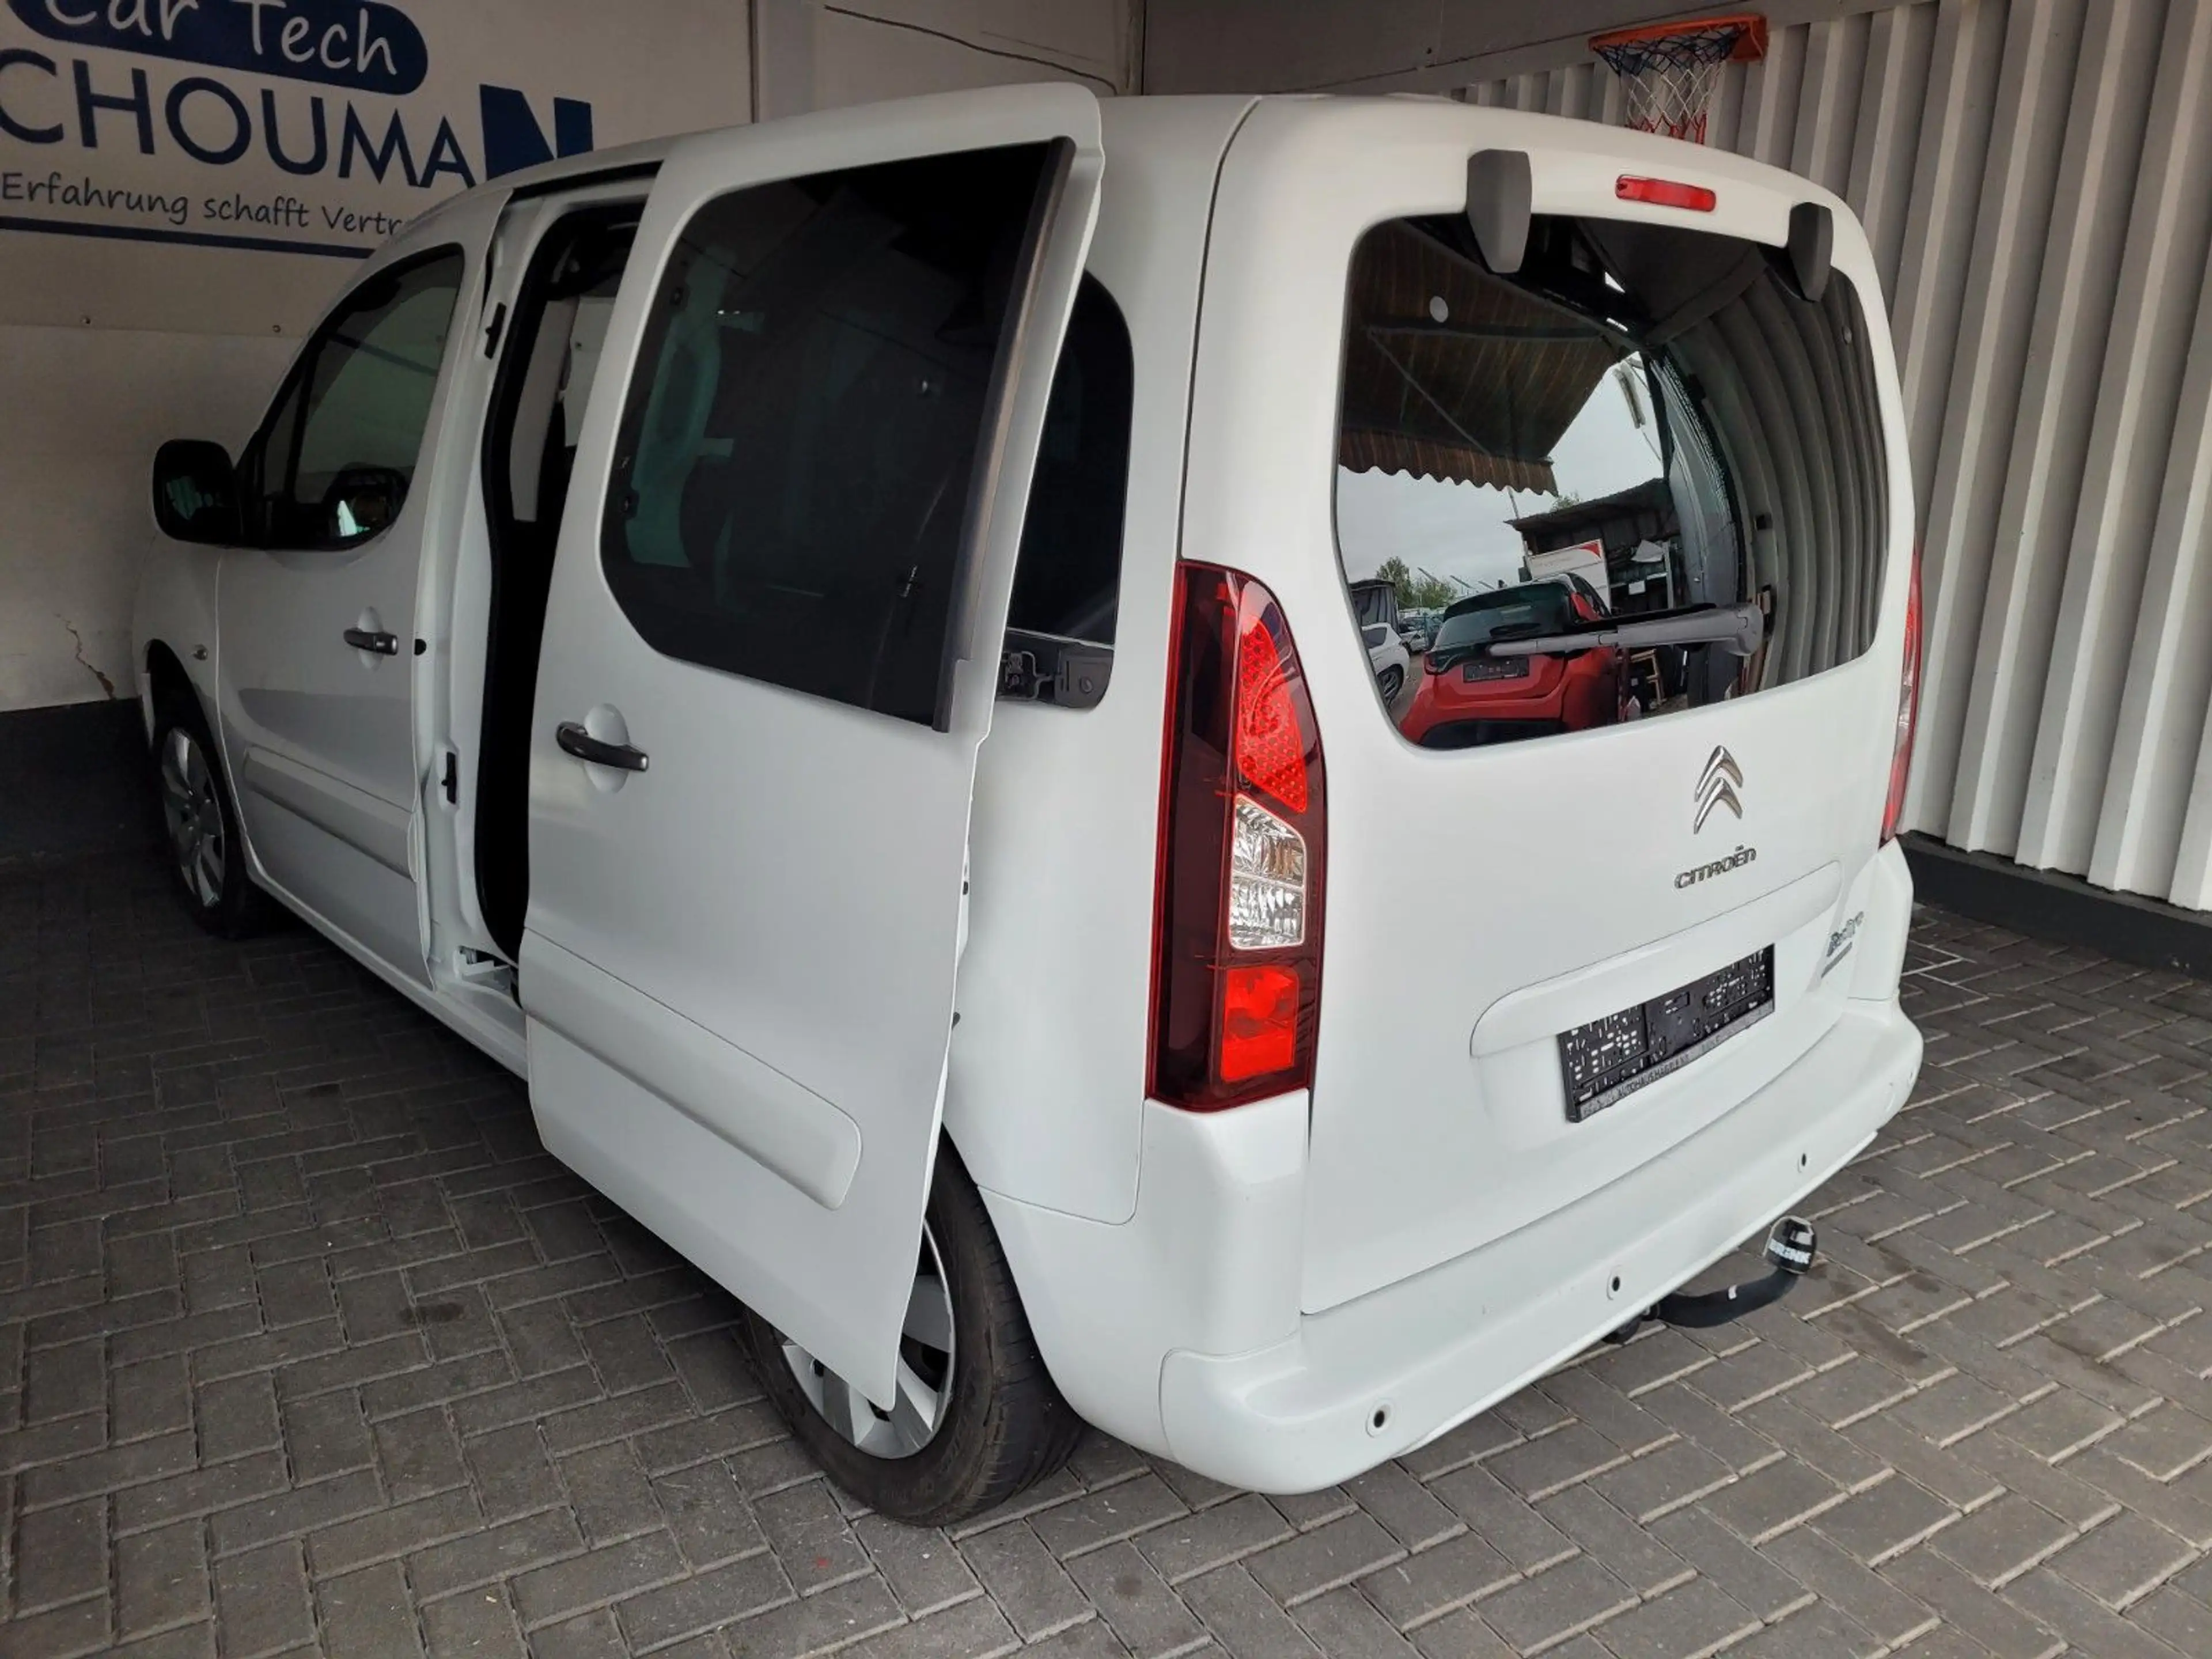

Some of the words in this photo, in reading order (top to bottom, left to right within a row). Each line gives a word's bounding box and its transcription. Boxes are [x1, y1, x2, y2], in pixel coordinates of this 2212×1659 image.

[233, 0, 397, 76] Tech
[2, 171, 189, 225] Erfahrung
[203, 192, 310, 227] schafft
